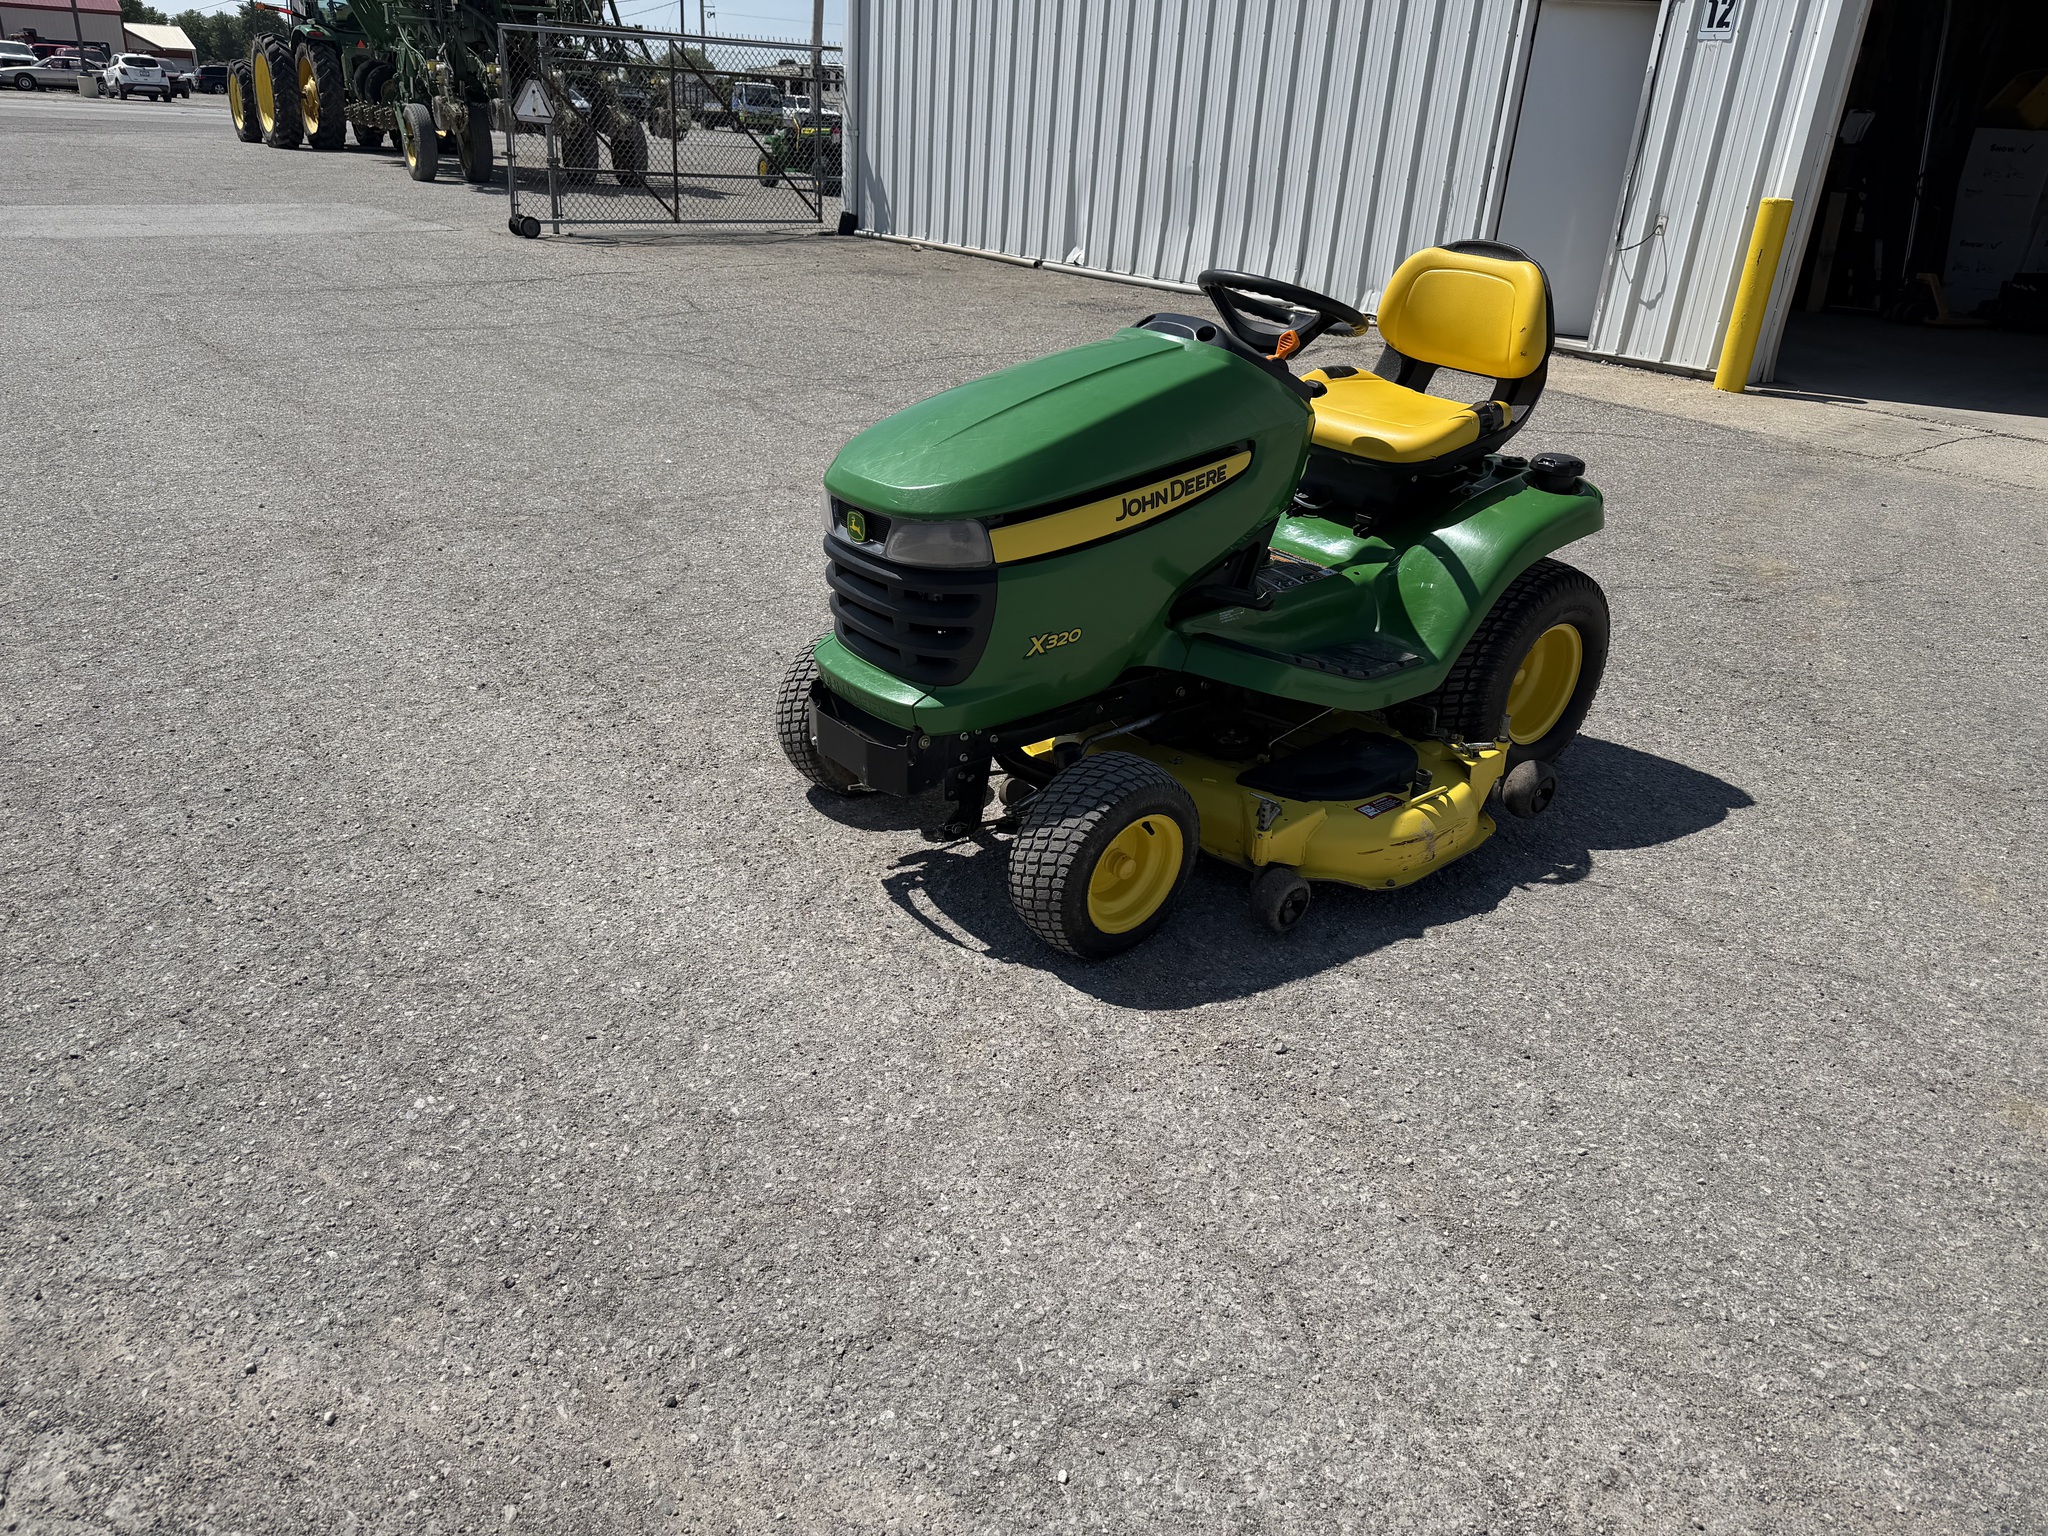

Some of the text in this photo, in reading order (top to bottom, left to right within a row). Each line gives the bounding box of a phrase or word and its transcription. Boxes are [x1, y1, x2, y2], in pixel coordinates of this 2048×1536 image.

[1707, 0, 1736, 28] 12
[1116, 464, 1227, 521] JOHN DEERE
[1023, 628, 1082, 659] X320
